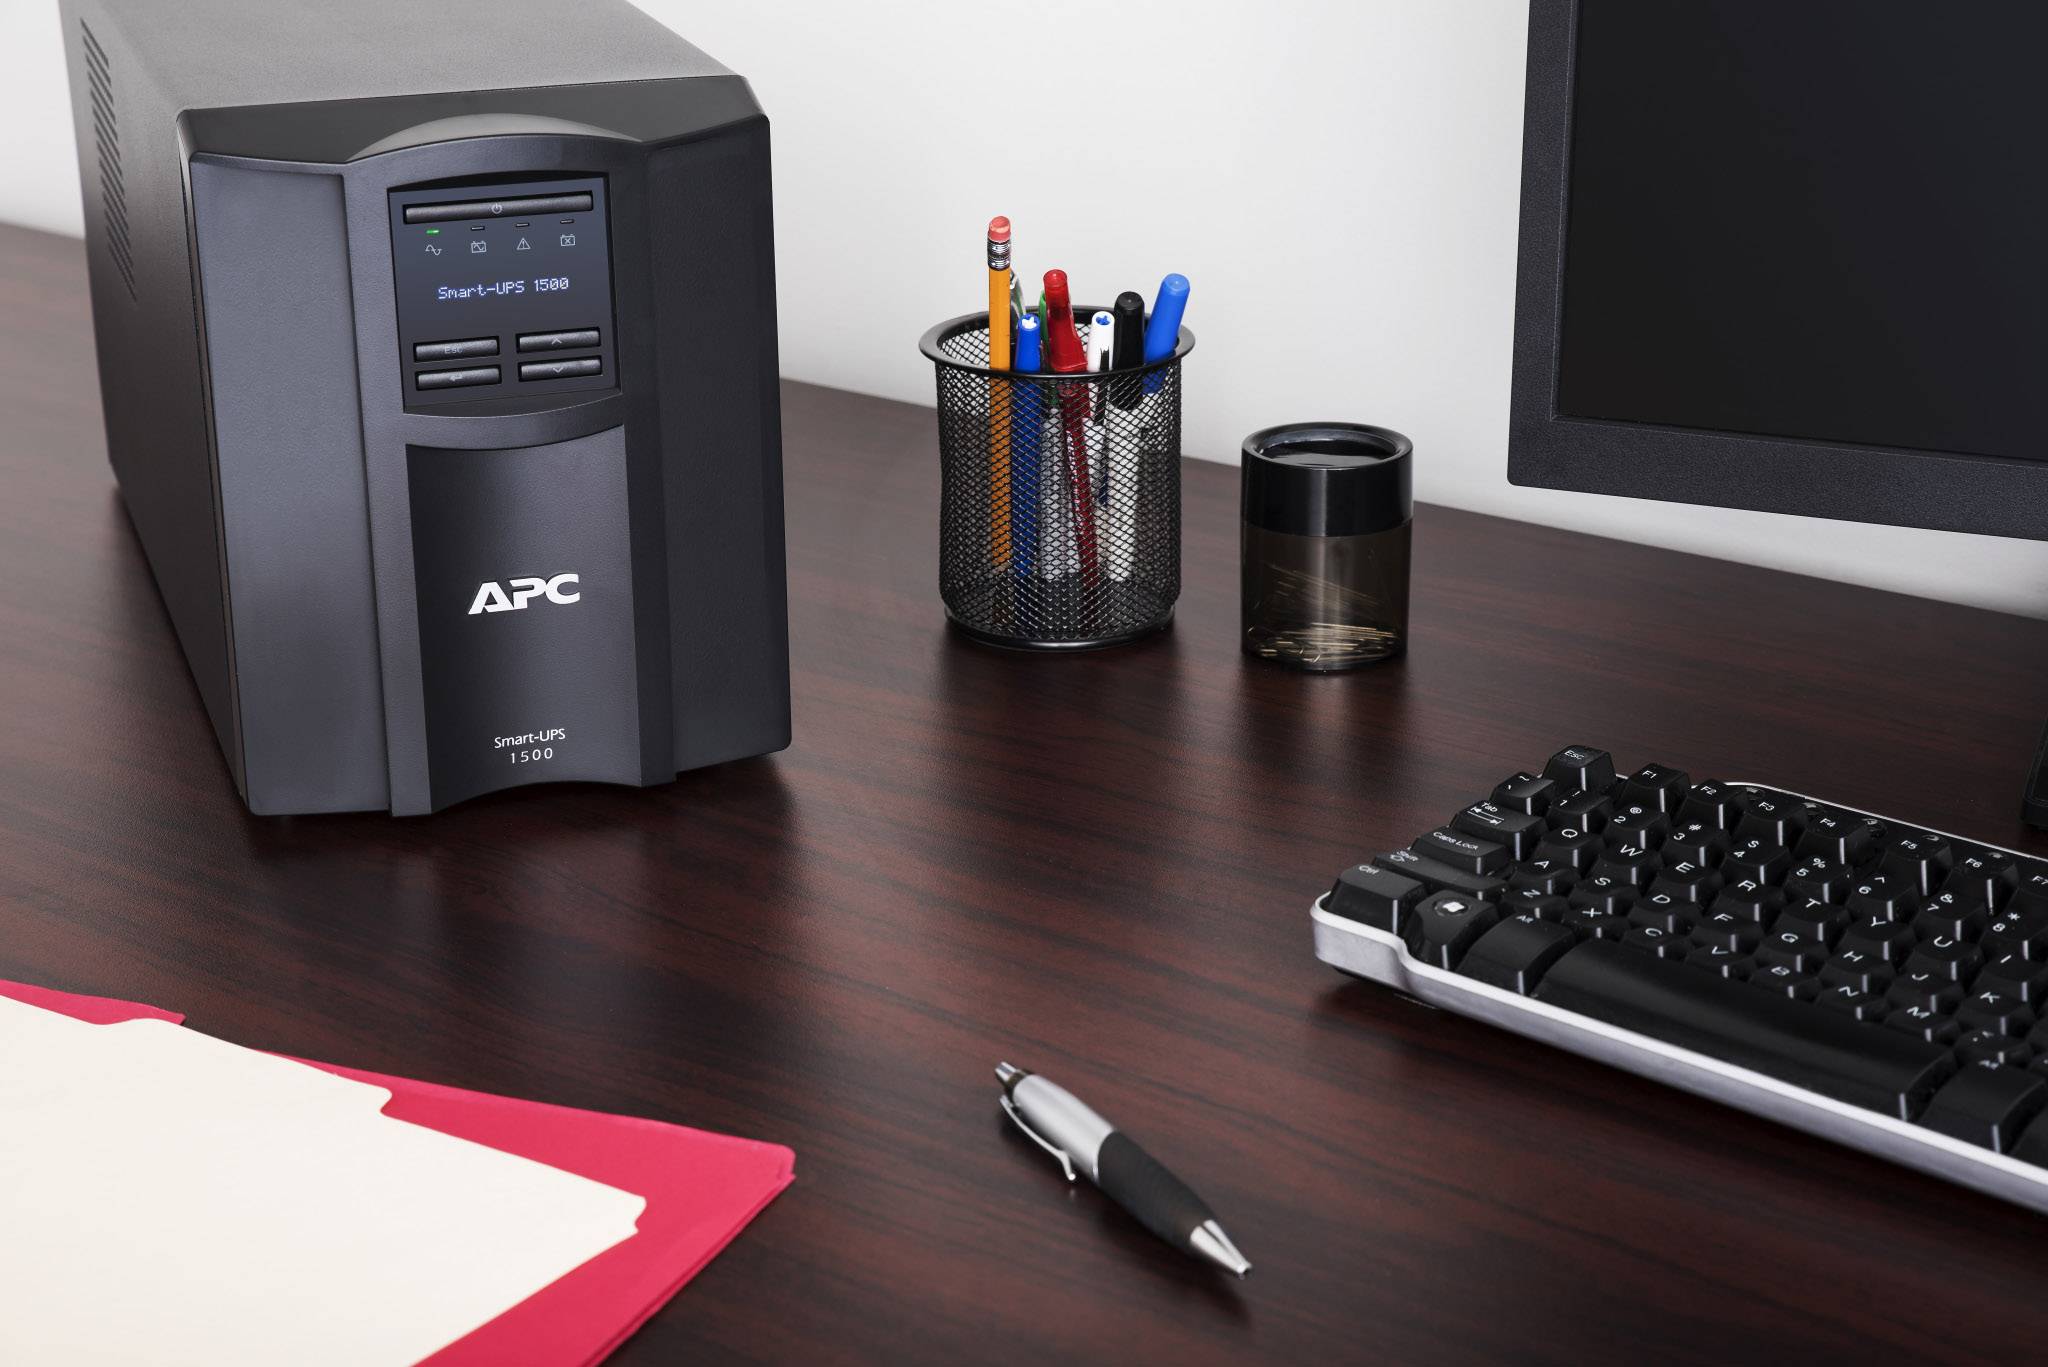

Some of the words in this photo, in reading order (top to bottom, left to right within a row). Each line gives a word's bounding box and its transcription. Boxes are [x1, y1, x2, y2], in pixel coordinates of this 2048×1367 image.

[438, 280, 525, 299] Smart-UPS
[534, 277, 569, 293] 1500
[468, 573, 581, 615] APC
[494, 728, 566, 749] Smart-UPS
[510, 747, 553, 764] 1500
[1642, 770, 1657, 779] F1
[1700, 785, 1717, 795] F2
[1481, 802, 1498, 813] Tab
[1758, 801, 1775, 811] F3
[1613, 815, 1626, 824] 2
[1819, 818, 1836, 828] F4
[1561, 828, 1578, 838] Q
[1673, 832, 1686, 841] 3
[1900, 840, 1918, 850] F5
[1619, 844, 1644, 857] W
[1733, 850, 1746, 859] 4
[1533, 860, 1550, 869] A
[1675, 861, 1695, 874] E
[1965, 858, 1983, 868] F6
[1796, 867, 1809, 877] 5
[1594, 876, 1611, 886] S
[1737, 879, 1757, 892] R
[1858, 885, 1872, 895] 6
[1652, 894, 1671, 904] D
[1805, 898, 1821, 908] T
[1581, 907, 1602, 918] X
[1713, 913, 1734, 922] F
[1870, 916, 1887, 927] Y
[1645, 927, 1663, 937] C
[1781, 932, 1799, 943] G
[1933, 935, 1953, 948] U
[1711, 946, 1729, 955] V
[1843, 950, 1864, 962] H
[1770, 965, 1790, 976] B
[1911, 973, 1929, 981] J
[1837, 986, 1859, 997] N
[1979, 991, 2000, 1004] K
[1906, 1006, 1931, 1019] M
